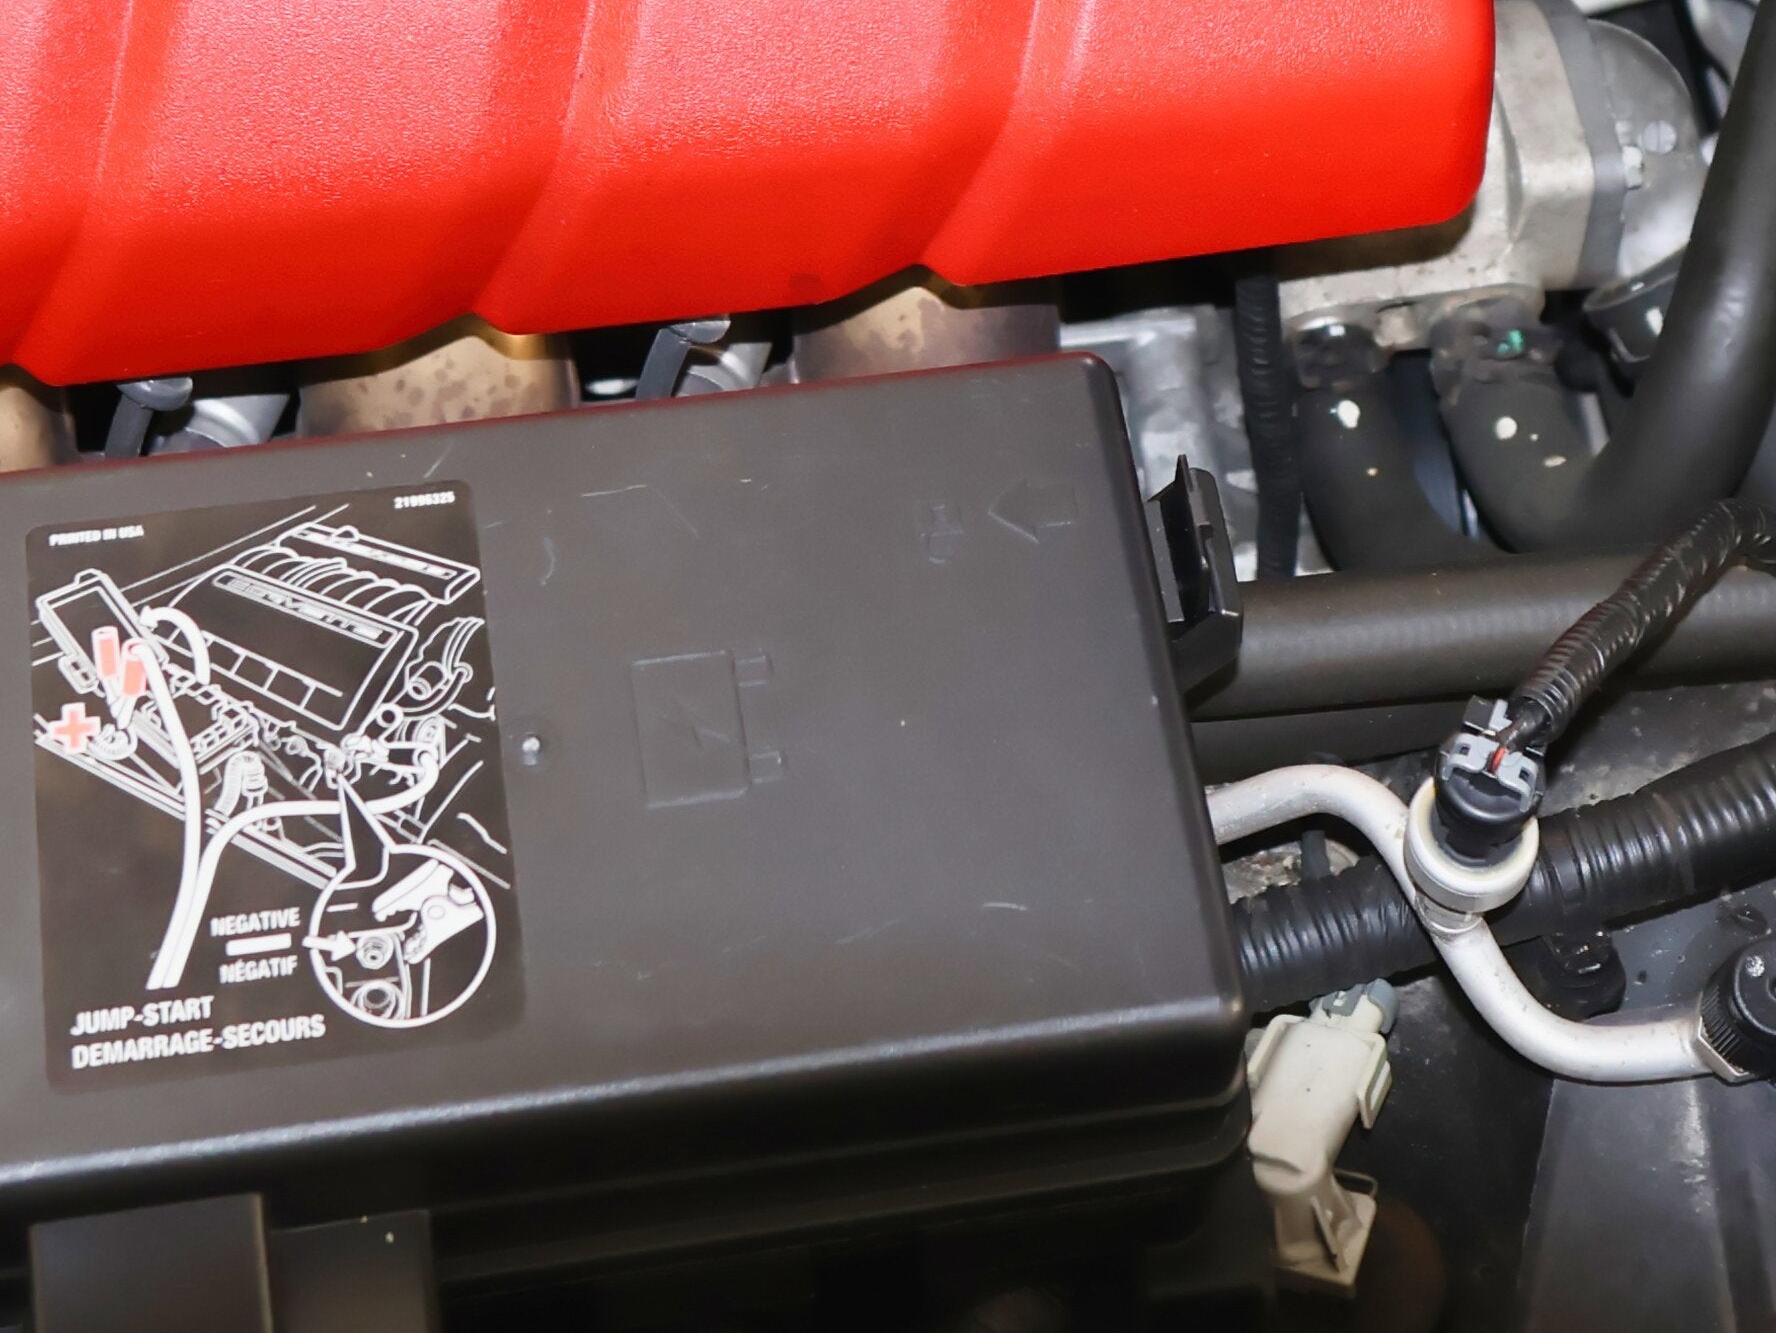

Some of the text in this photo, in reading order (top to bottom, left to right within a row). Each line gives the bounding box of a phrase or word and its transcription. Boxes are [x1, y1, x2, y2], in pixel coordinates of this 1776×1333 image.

[209, 906, 301, 938] NEGATIVE
[219, 954, 299, 984] NÉGATIF
[69, 994, 215, 1036] JUMP-START
[71, 1013, 326, 1070] DEMARRAGE-SECOURS
